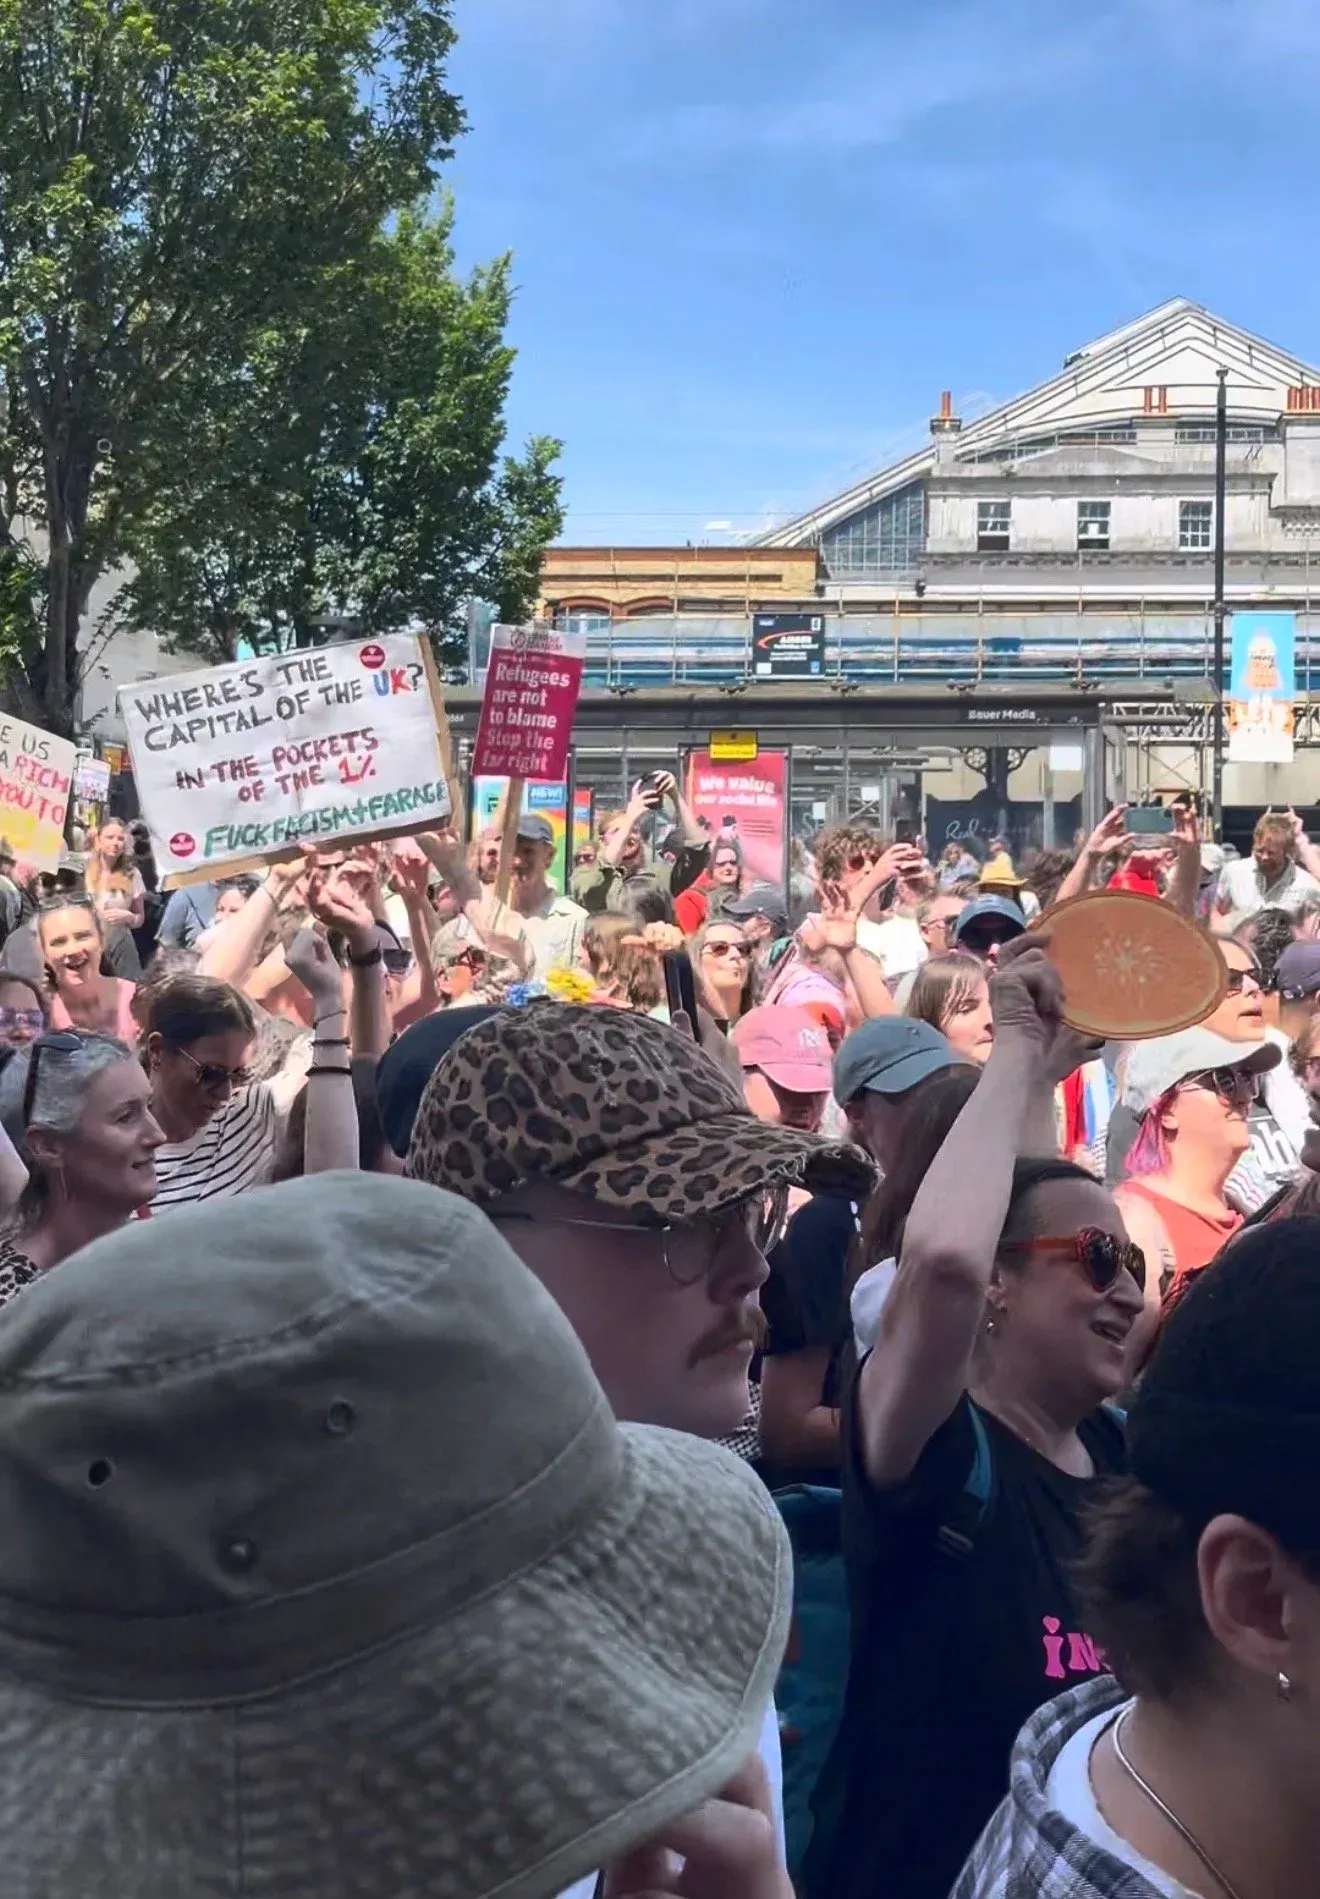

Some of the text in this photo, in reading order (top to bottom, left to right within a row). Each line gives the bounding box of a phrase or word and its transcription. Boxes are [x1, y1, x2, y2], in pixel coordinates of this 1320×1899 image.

[496, 663, 571, 688] Refugees
[135, 656, 332, 722] WHERE'S THE
[493, 688, 548, 707] are not
[144, 663, 424, 752] CAPITAL OF THE UK?
[489, 708, 557, 729] to blame
[1002, 709, 1036, 720] Media
[22, 733, 50, 760] US
[487, 727, 555, 751] Stop the
[175, 727, 380, 791] IN THE POCKETS
[481, 750, 507, 768] far
[507, 751, 548, 773] right
[14, 754, 69, 793] RICH
[238, 754, 377, 803] OF THE 1%
[727, 775, 776, 795] value
[204, 822, 268, 857] FUCK
